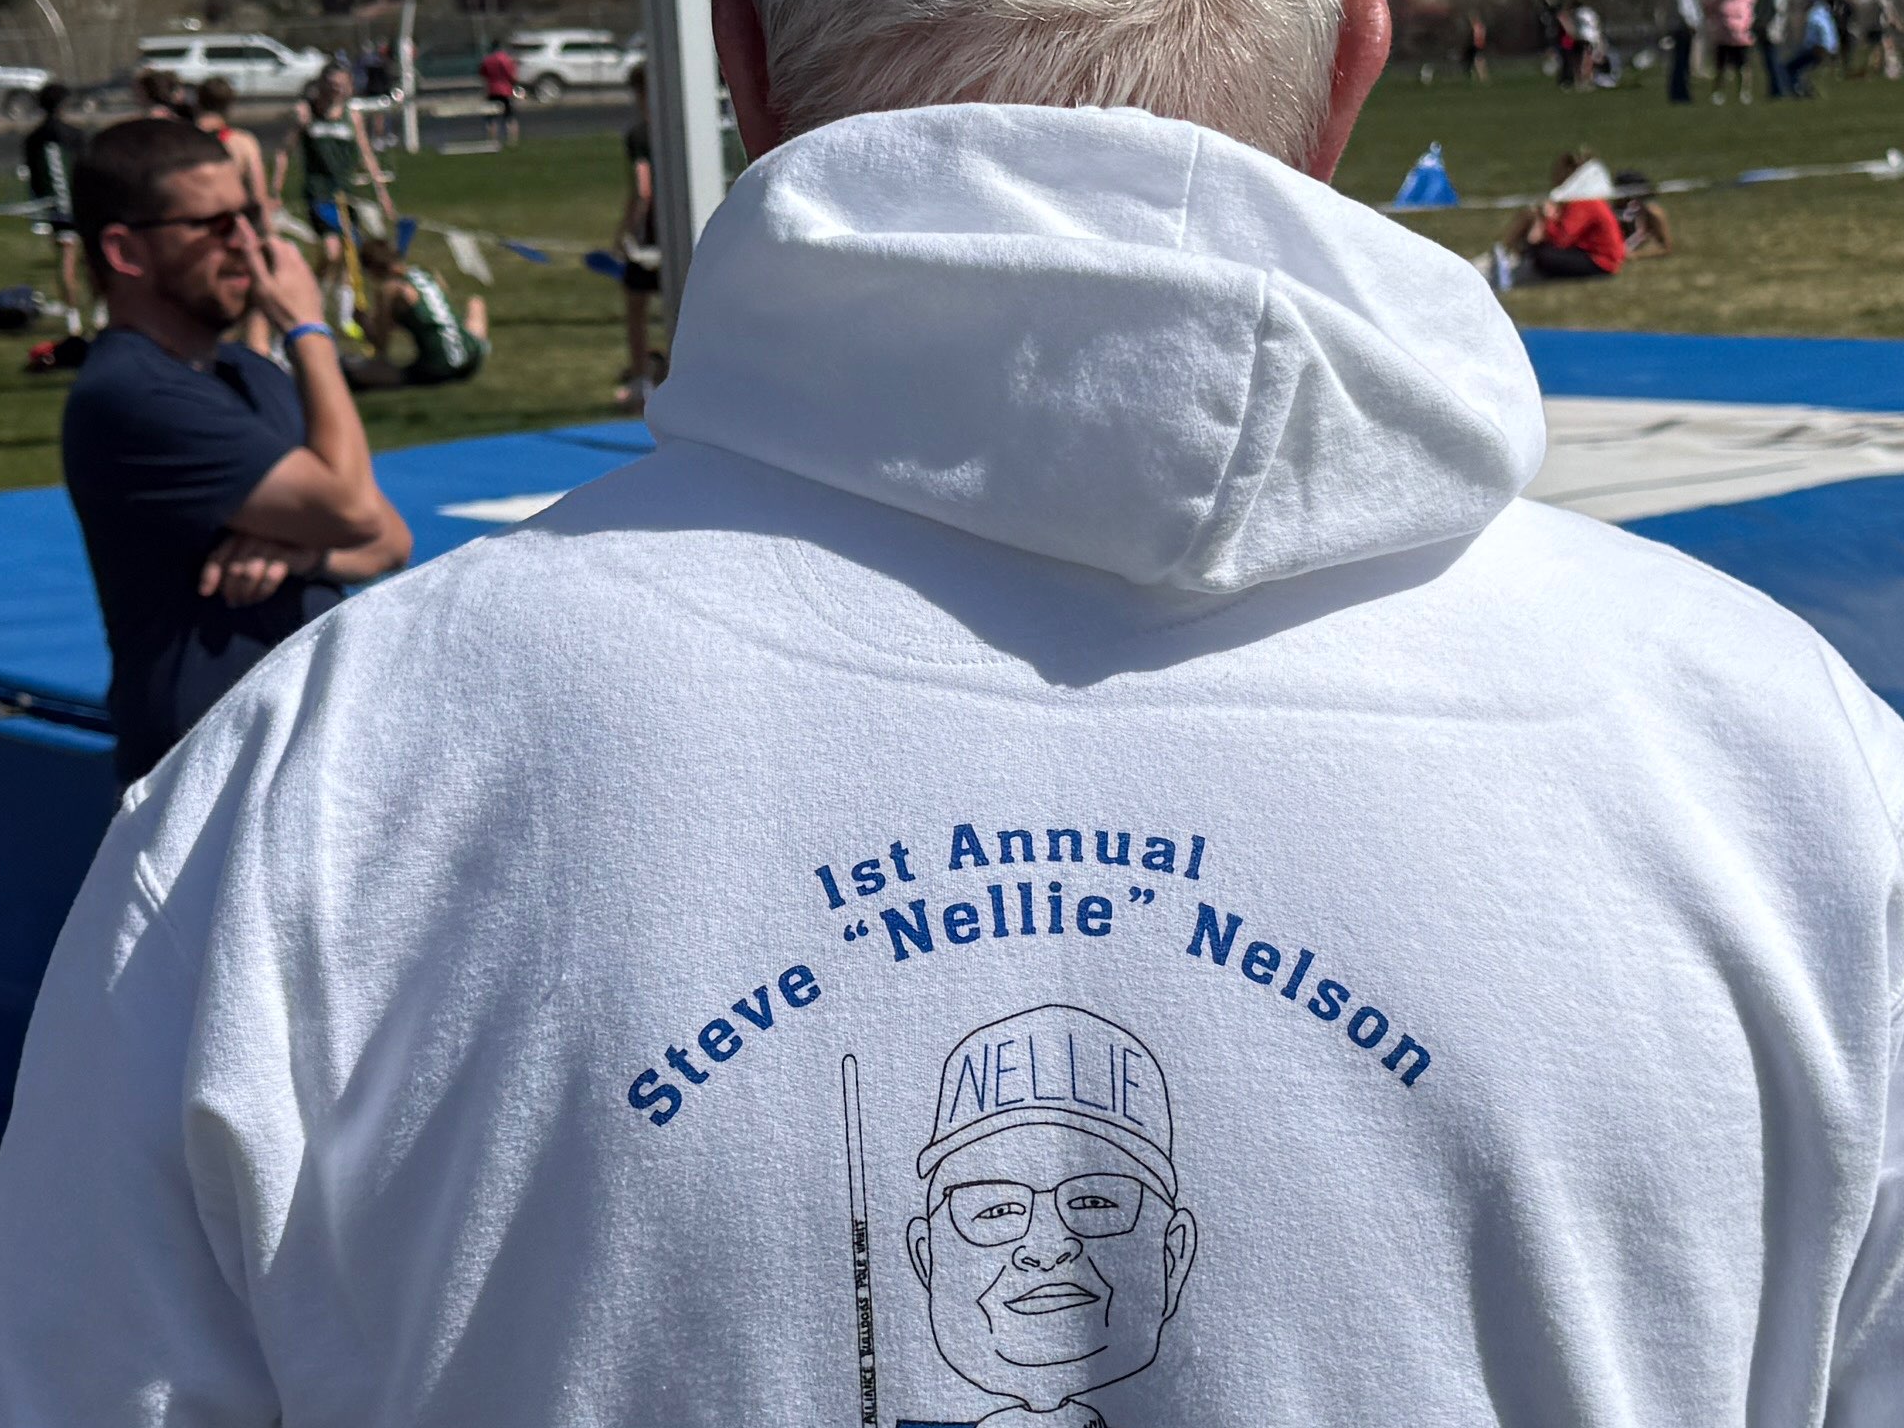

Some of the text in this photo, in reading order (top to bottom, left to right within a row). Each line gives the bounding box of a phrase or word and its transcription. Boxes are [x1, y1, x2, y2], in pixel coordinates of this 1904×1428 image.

[814, 823, 1206, 910] 1st Annual
[627, 881, 1432, 1128] Steve “Nellie” Nelson
[948, 1033, 1145, 1127] NELLIE
